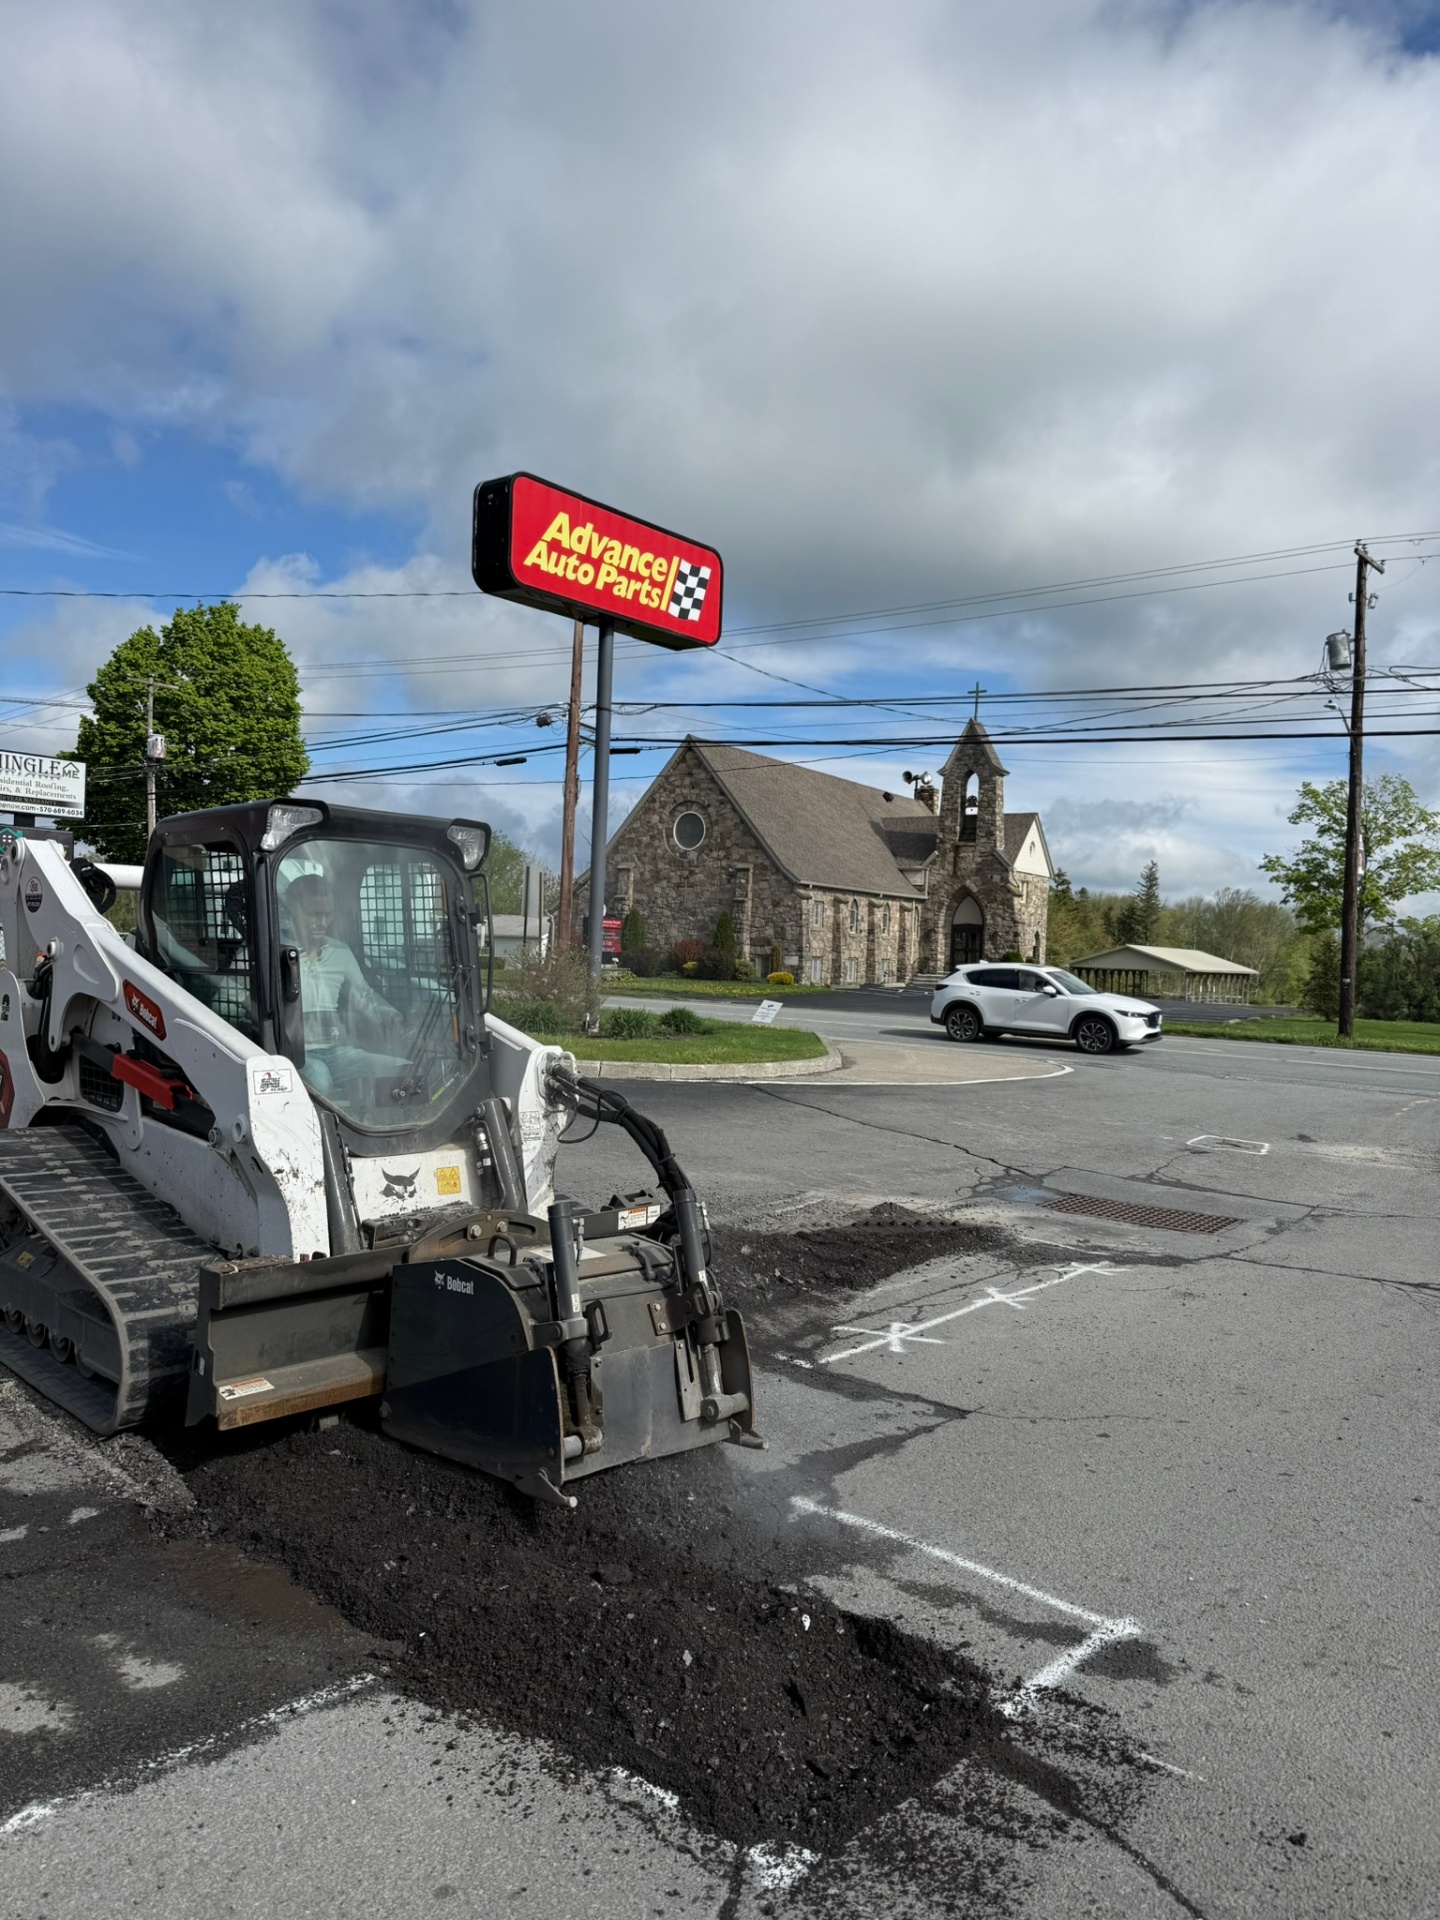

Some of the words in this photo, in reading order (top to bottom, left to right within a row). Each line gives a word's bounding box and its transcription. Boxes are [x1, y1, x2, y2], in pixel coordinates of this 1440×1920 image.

[541, 512, 668, 582] Advance
[523, 540, 595, 585] Auto
[595, 563, 662, 609] Parts
[25, 787, 77, 799] Replacements
[35, 781, 69, 793] Roofing,
[139, 1003, 157, 1029] Bobcat
[446, 1275, 474, 1295] Bobcat
